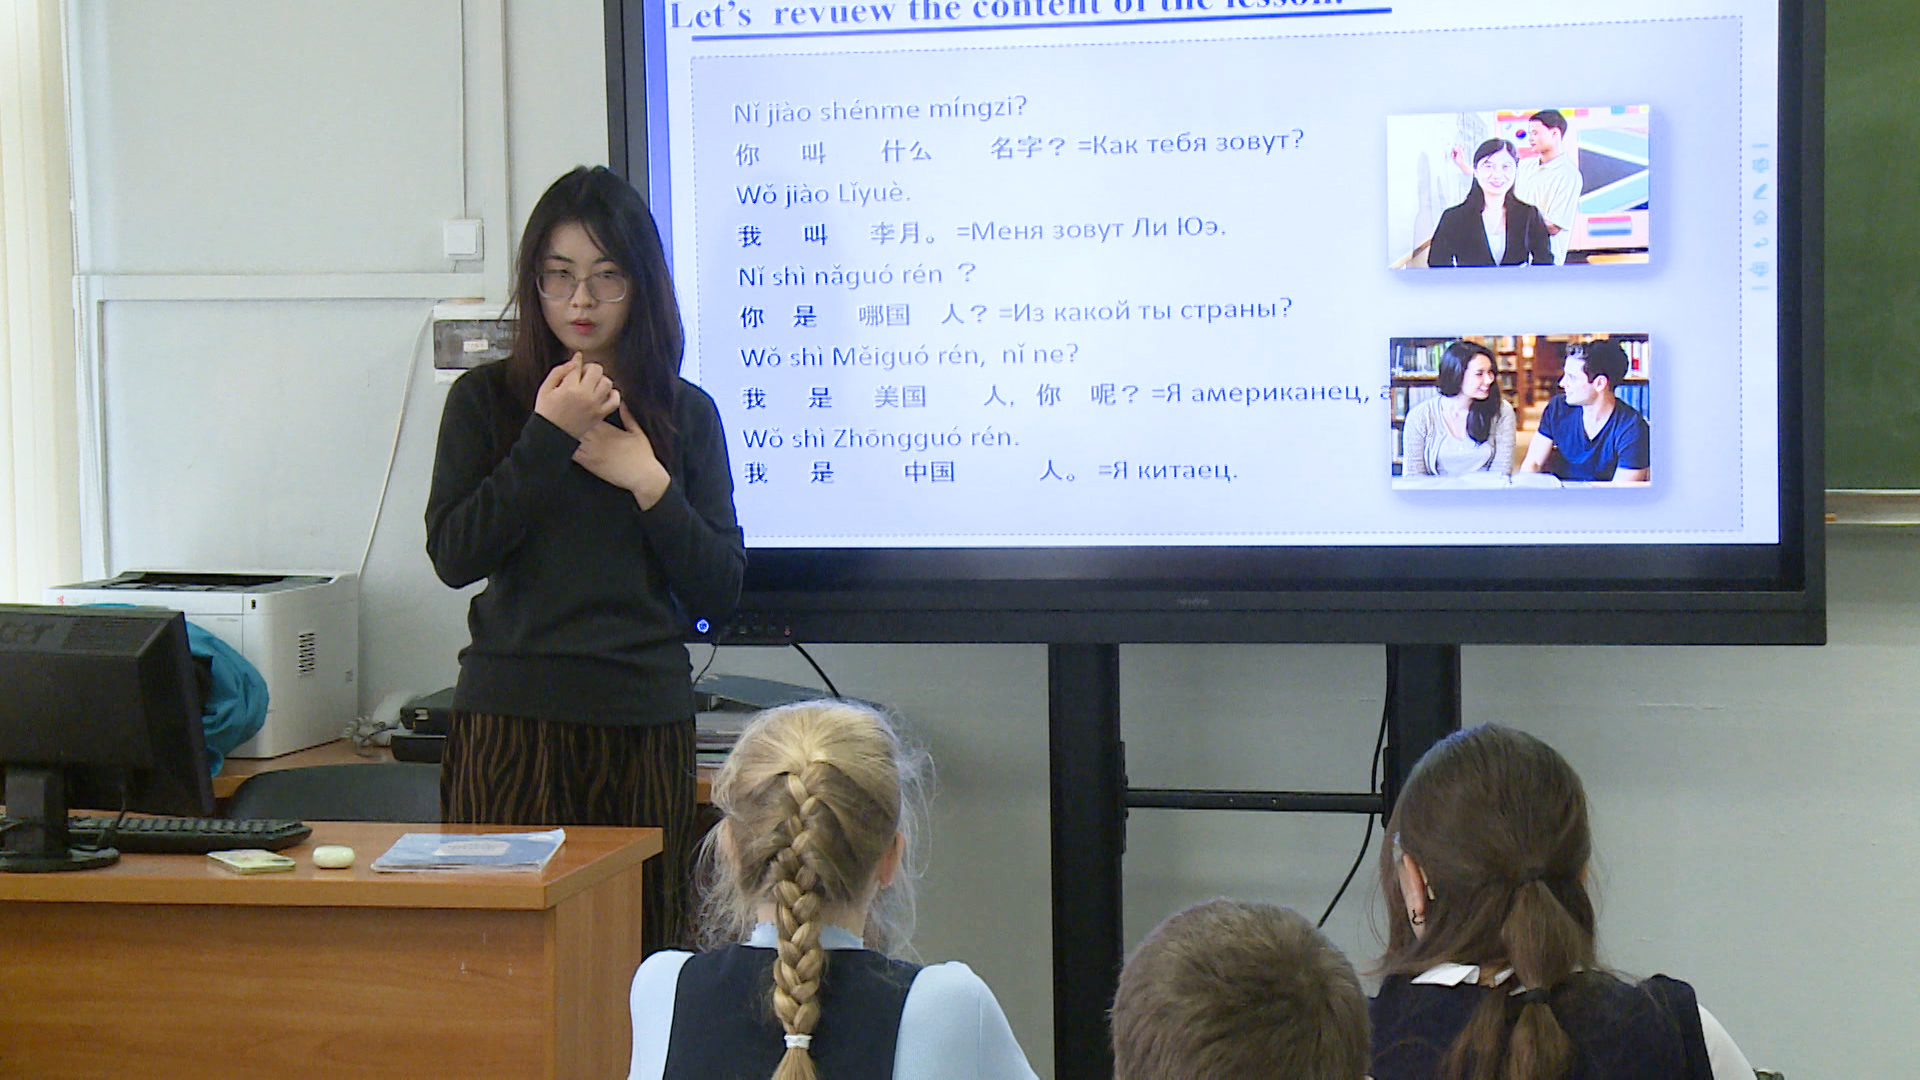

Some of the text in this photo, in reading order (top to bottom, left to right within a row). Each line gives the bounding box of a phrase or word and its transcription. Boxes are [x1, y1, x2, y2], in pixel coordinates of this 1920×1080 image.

[775, 3, 896, 25] revuew
[908, 0, 961, 21] the
[973, 0, 1102, 18] content
[735, 95, 1028, 128] Nǐ jiào shénme míngzi?
[736, 144, 760, 167] 你
[803, 142, 826, 165] 叫
[882, 139, 932, 163] 什么
[1078, 135, 1138, 155] =Как
[1146, 131, 1206, 153] тебя
[1216, 128, 1304, 155] зовут?
[736, 181, 910, 209] Wǒ jiào Lǐyuè.
[738, 225, 762, 248] 我
[805, 223, 828, 247] 叫
[957, 221, 1043, 241] =Меня
[1053, 223, 1124, 243] зовут
[1132, 217, 1167, 238] Ли
[1178, 216, 1226, 236] Юэ.
[740, 266, 765, 287] Nǐ
[773, 266, 805, 286] shì
[816, 264, 893, 290] nǎguó
[903, 264, 942, 284] rén
[740, 306, 764, 329] 你
[793, 305, 817, 328] 是
[859, 304, 910, 327] 哪国
[999, 303, 1044, 322] =Из
[1055, 300, 1129, 321] какой
[1138, 304, 1171, 320] ты
[1181, 297, 1292, 324] страны?
[741, 343, 1078, 371] Wǒ shì Měiguó rén, nǐ ne?
[743, 387, 766, 410] 我
[809, 387, 832, 409] 是
[875, 385, 926, 408] 美国
[1036, 383, 1061, 407] 你
[1152, 383, 1181, 403] =Я
[1192, 385, 1369, 407] американец,
[743, 426, 1019, 452] Wǒ shì Zhōngguó rén.
[744, 462, 768, 484] 我
[811, 461, 834, 484] 是
[905, 460, 955, 483] 中国
[1099, 460, 1128, 480] =Я
[1139, 464, 1238, 483] китаец.
